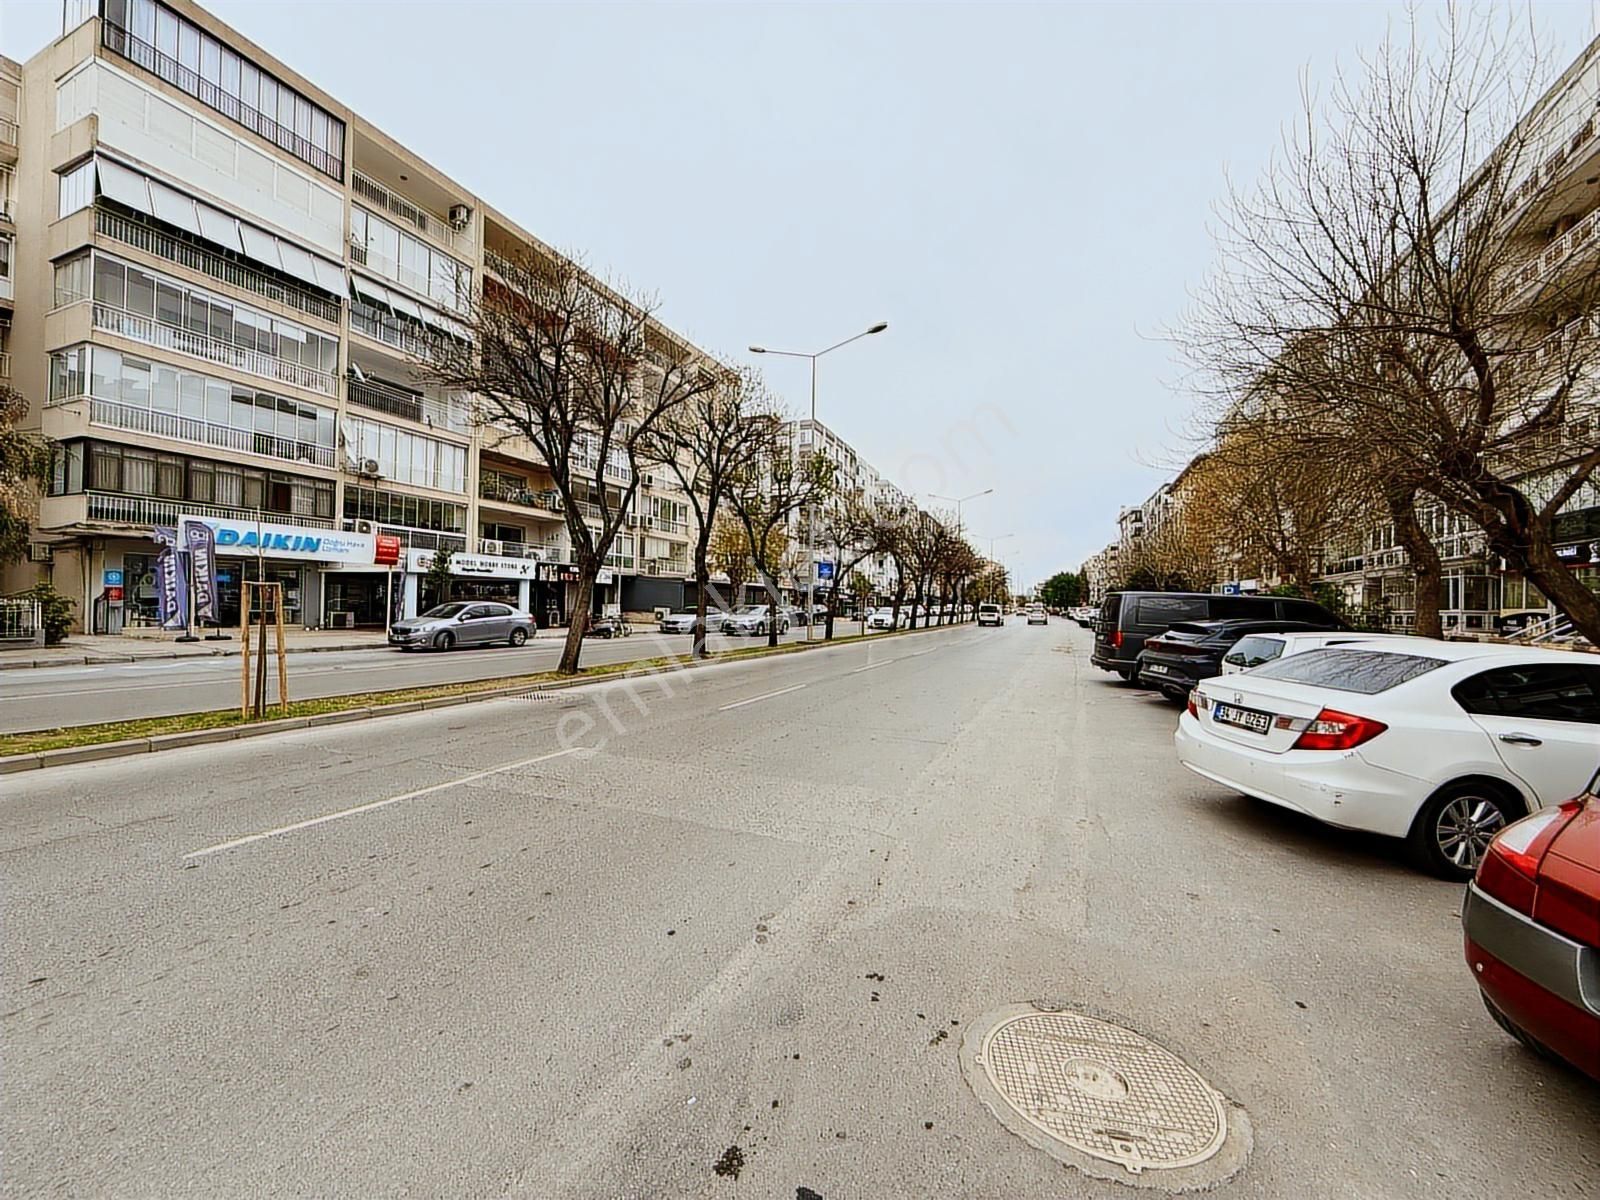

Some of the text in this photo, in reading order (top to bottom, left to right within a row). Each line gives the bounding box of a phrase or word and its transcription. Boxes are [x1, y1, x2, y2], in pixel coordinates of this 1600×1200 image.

[215, 528, 321, 552] DAIKIN
[163, 554, 177, 613] DAIKIN
[194, 547, 210, 604] DAIKIN
[1220, 706, 1230, 719] 34
[1245, 712, 1268, 728] 0263
